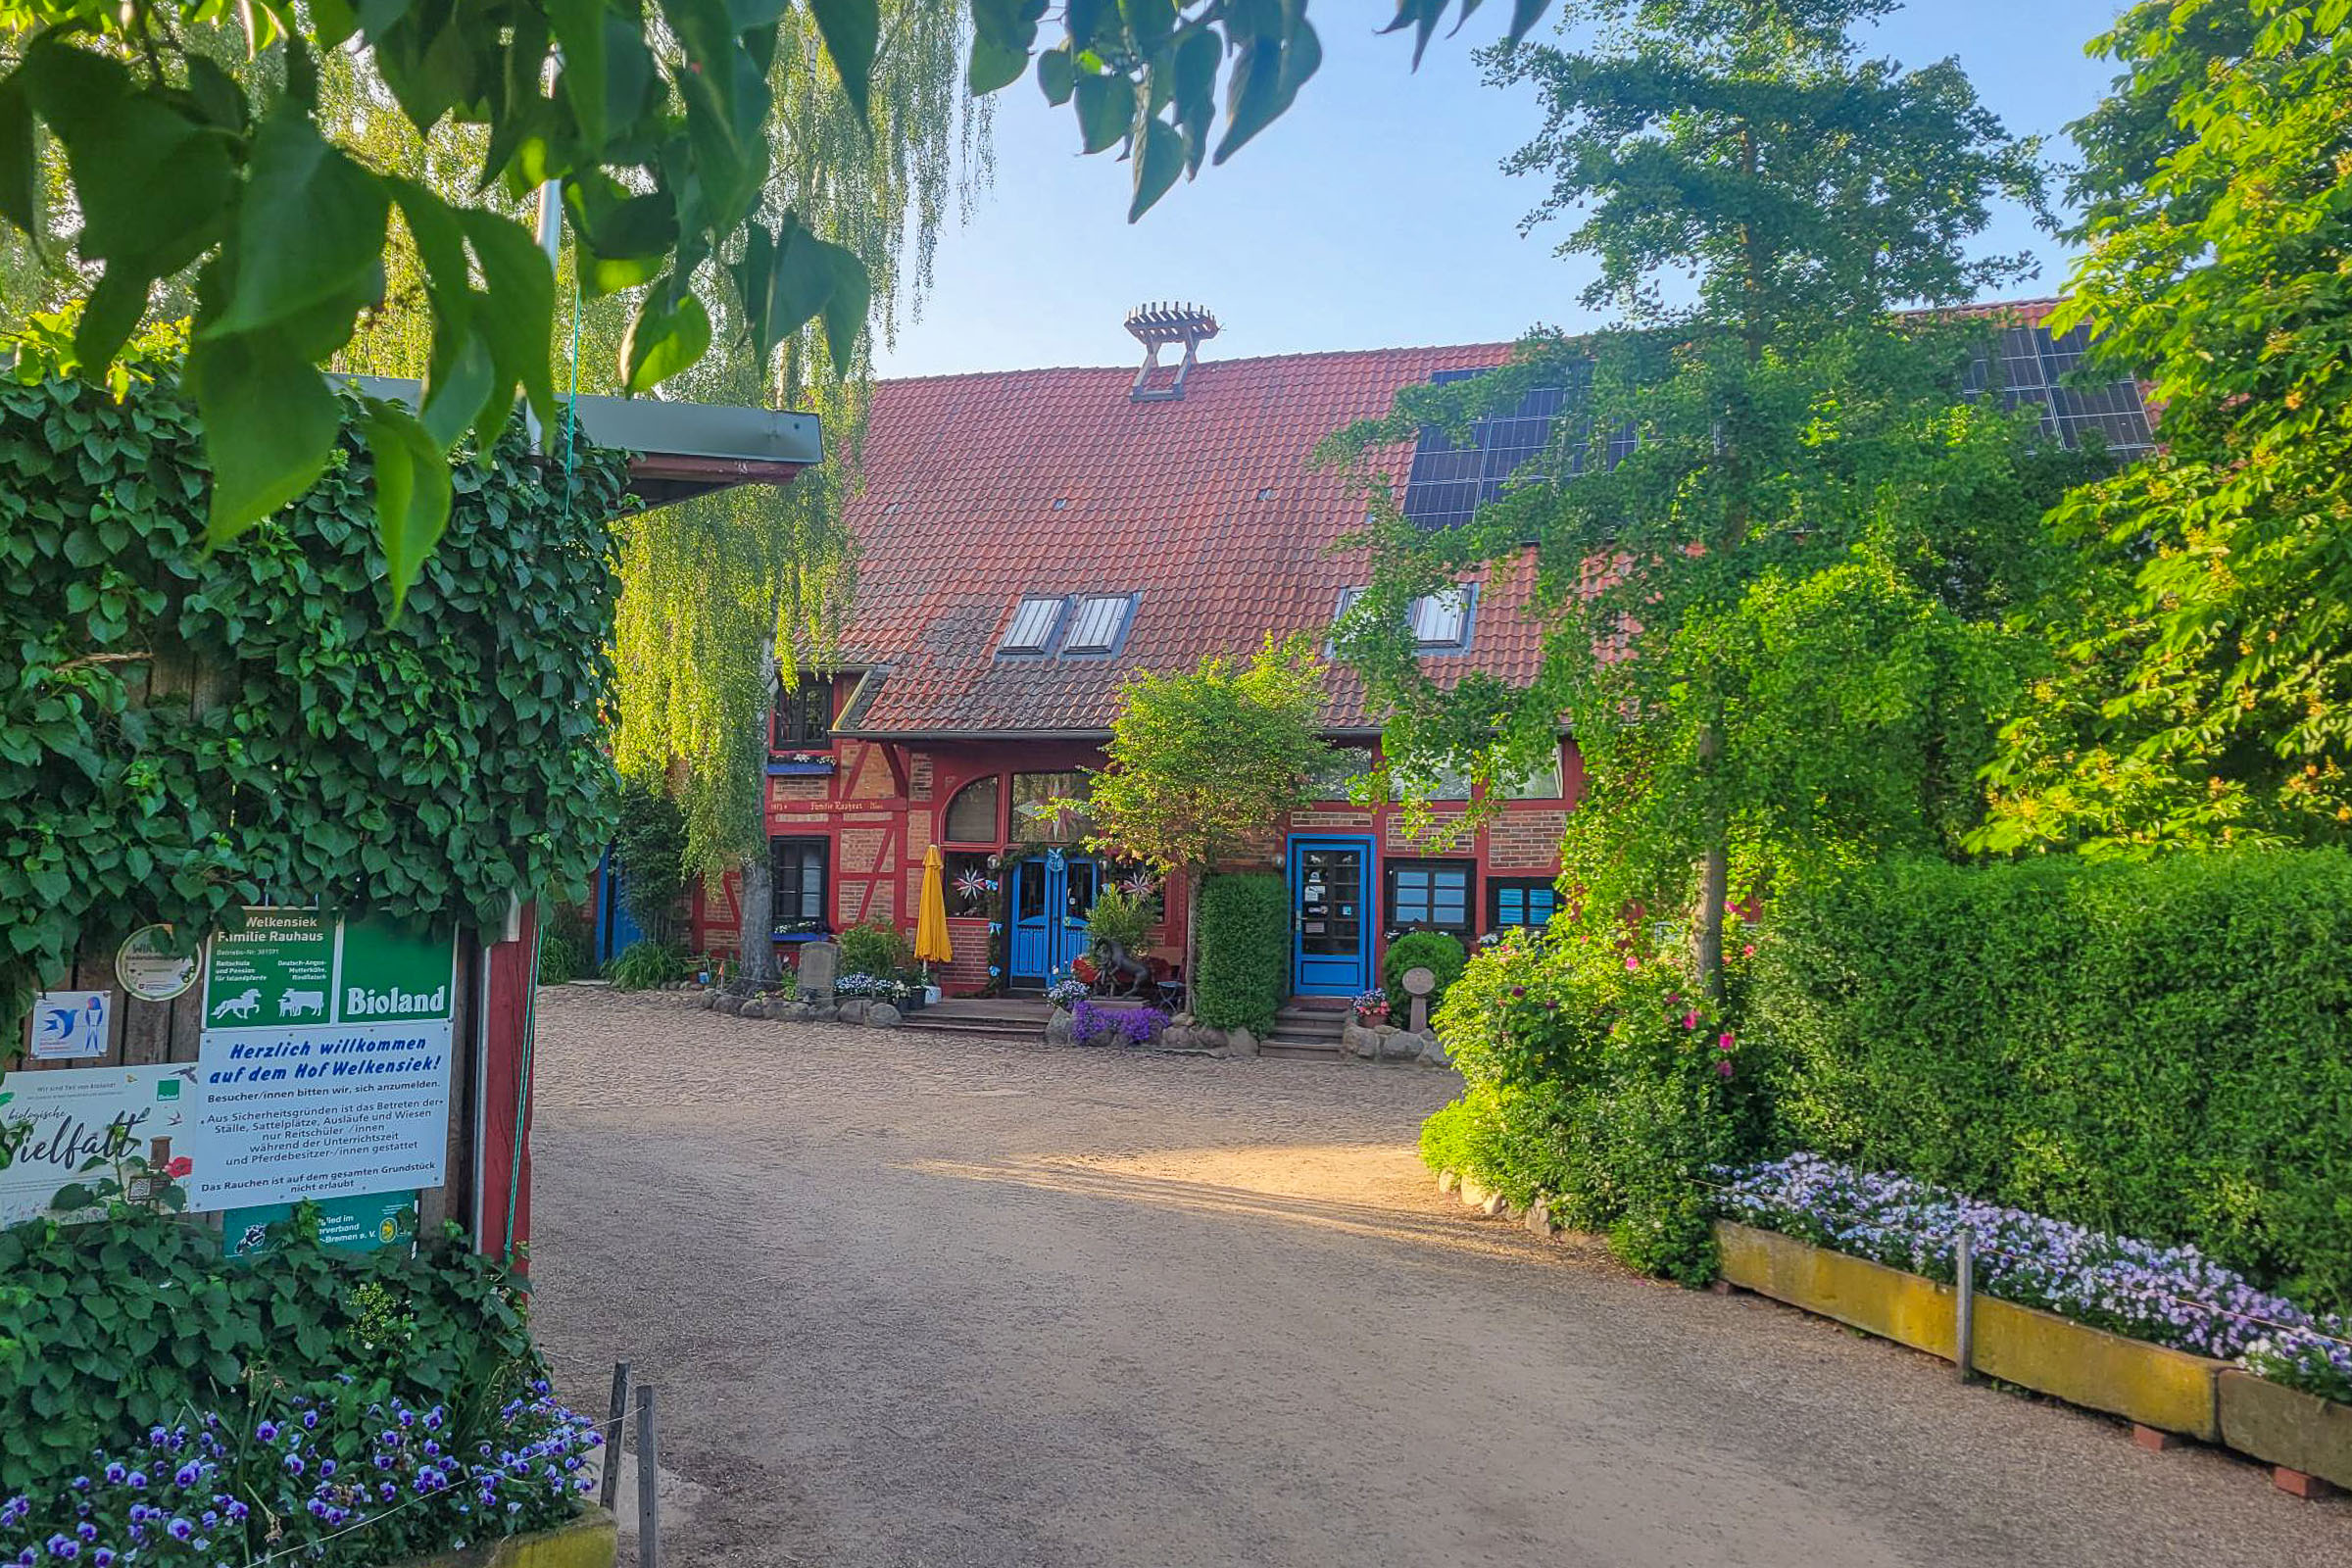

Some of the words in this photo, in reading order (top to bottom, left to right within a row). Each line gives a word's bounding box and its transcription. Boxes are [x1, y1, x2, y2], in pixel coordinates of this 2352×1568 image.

[270, 930, 324, 942] Rauhaus
[346, 985, 445, 1015] Bioland
[230, 1041, 311, 1059] Herzlich
[319, 1038, 426, 1054] willkommen
[209, 1066, 246, 1084] auf
[248, 1065, 287, 1082] dem
[294, 1061, 330, 1079] Hof
[332, 1054, 442, 1076] Welkensiek!
[208, 1091, 294, 1103] Besucher/innen
[297, 1087, 329, 1097] bitten
[332, 1085, 352, 1095] wir,
[355, 1083, 374, 1093] sich
[377, 1080, 440, 1091] anzumelden.
[8, 1105, 66, 1126] biologische
[207, 1113, 228, 1124] Aus
[232, 1105, 338, 1122] Sicherheitsgründen
[341, 1104, 353, 1113] ist
[356, 1102, 374, 1112] das
[376, 1100, 419, 1110] Betreten
[422, 1098, 440, 1107] der
[215, 1123, 250, 1134] Ställe,
[252, 1119, 320, 1131] Sattelplätze,
[323, 1114, 369, 1125] Ausläufe
[371, 1111, 393, 1121] und
[394, 1109, 431, 1120] Wiesen
[10, 1108, 148, 1170] ielfalt
[250, 1141, 299, 1152] während
[302, 1139, 320, 1149] der
[323, 1132, 399, 1147] Unterrichtszeit
[262, 1132, 282, 1141] nur
[284, 1126, 344, 1140] Reitschüler
[348, 1123, 385, 1134] /innen
[225, 1156, 248, 1166] und
[251, 1147, 369, 1163] Pferdebesitzer-/innen
[371, 1141, 417, 1154] gestattet
[201, 1183, 221, 1193] Das
[223, 1179, 270, 1190] Rauchen
[271, 1176, 284, 1185] ist
[286, 1173, 304, 1184] auf
[304, 1172, 328, 1182] dem
[330, 1167, 379, 1182] gesamten
[380, 1161, 436, 1174] Grundstück
[290, 1182, 316, 1194] nicht
[318, 1180, 354, 1190] erlaubt
